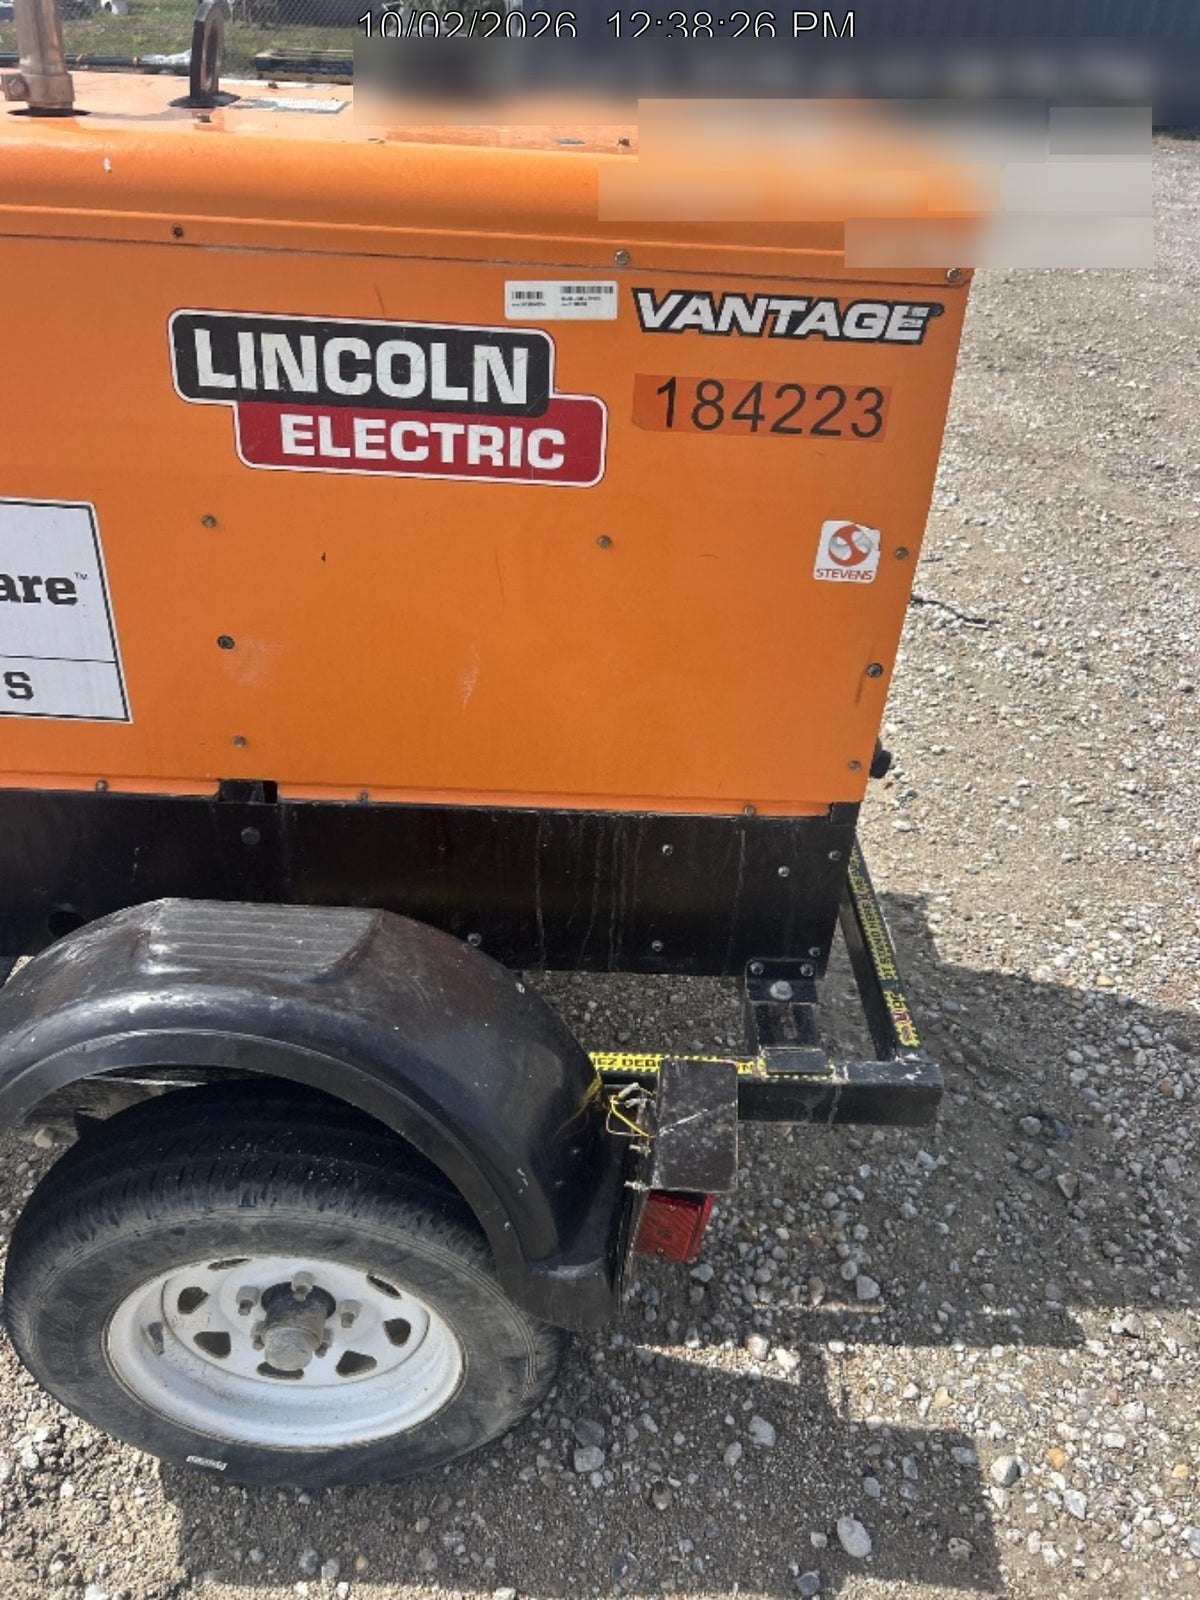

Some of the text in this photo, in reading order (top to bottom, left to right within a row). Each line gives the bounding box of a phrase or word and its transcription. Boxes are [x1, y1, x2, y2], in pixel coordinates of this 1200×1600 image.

[635, 291, 932, 342] VANTAGE
[194, 328, 529, 405] LINCOLN
[656, 376, 885, 438] 184223
[279, 413, 567, 470] ELECTRIC
[815, 568, 875, 580] STEVENS
